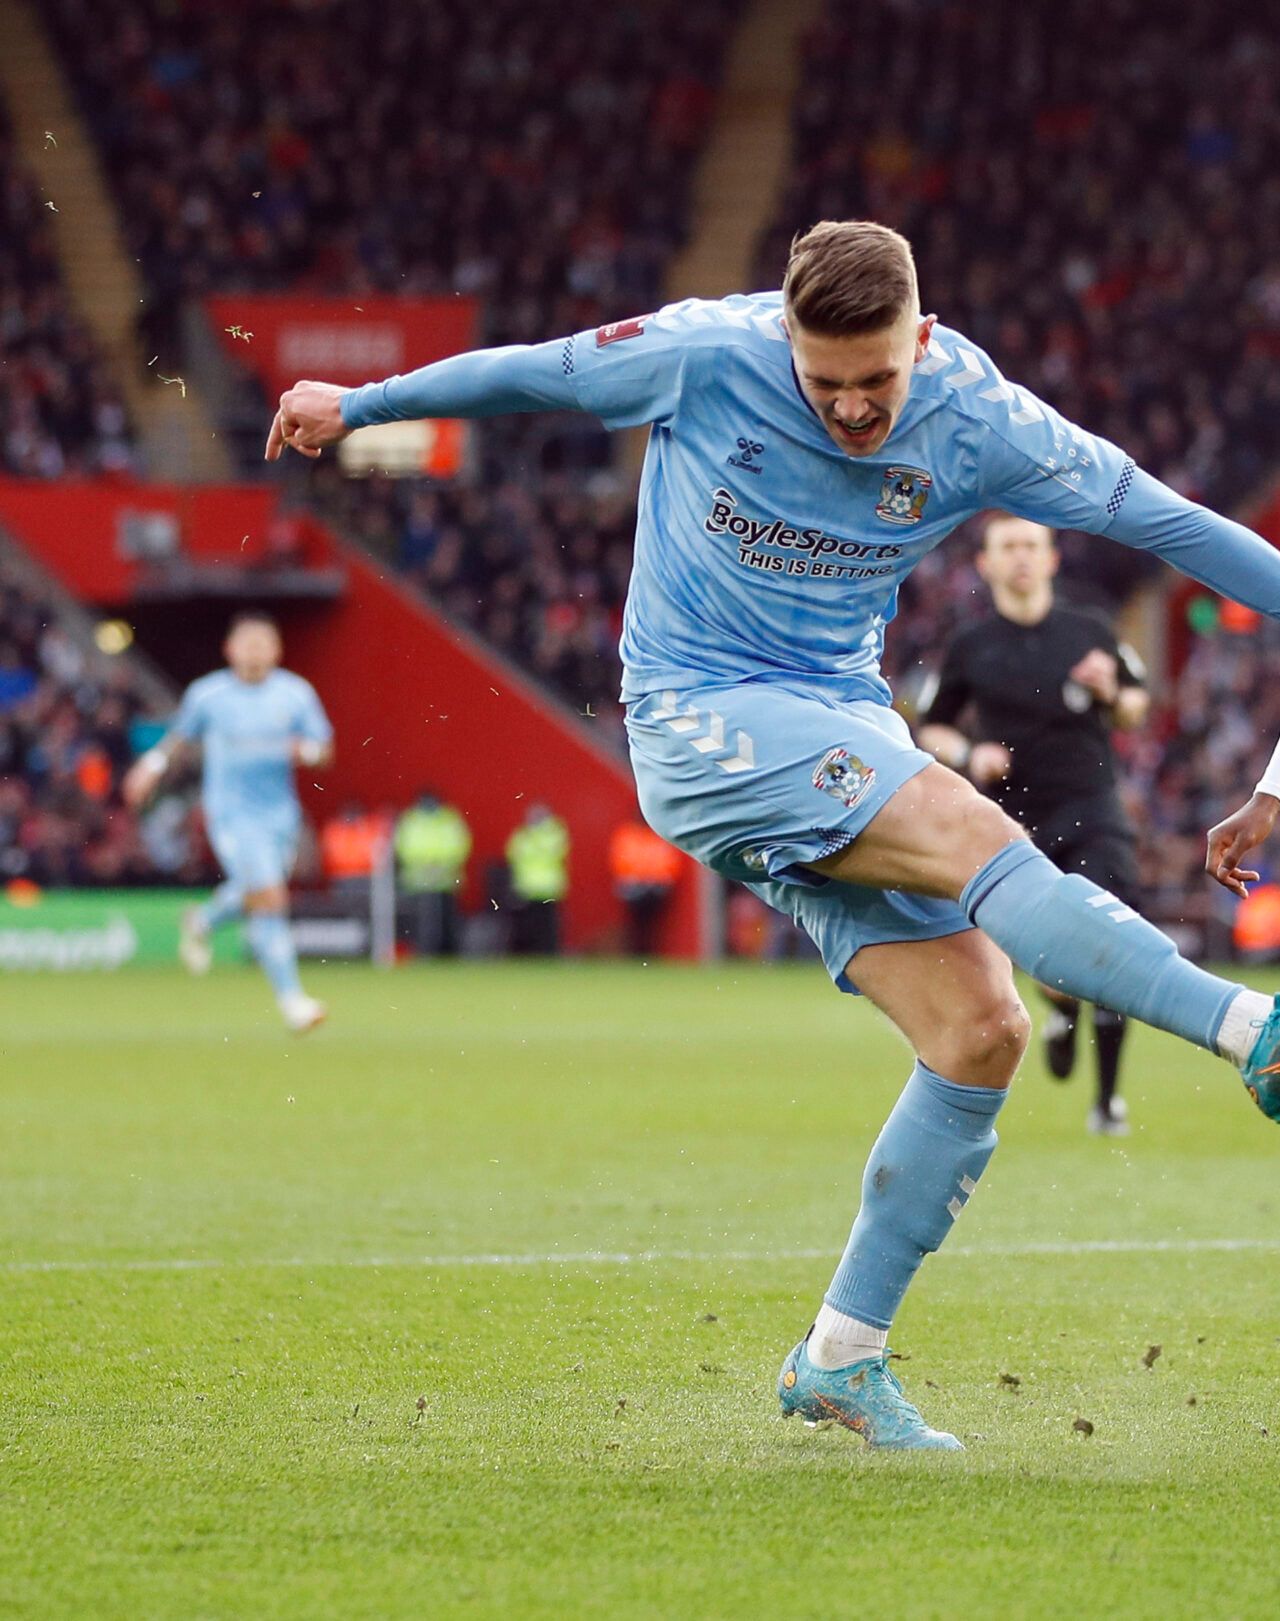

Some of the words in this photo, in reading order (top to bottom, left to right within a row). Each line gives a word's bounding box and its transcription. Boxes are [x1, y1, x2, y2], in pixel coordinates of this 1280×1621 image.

[706, 498, 902, 559] BoyleSports
[738, 548, 784, 572] THIS
[787, 559, 807, 575] IS
